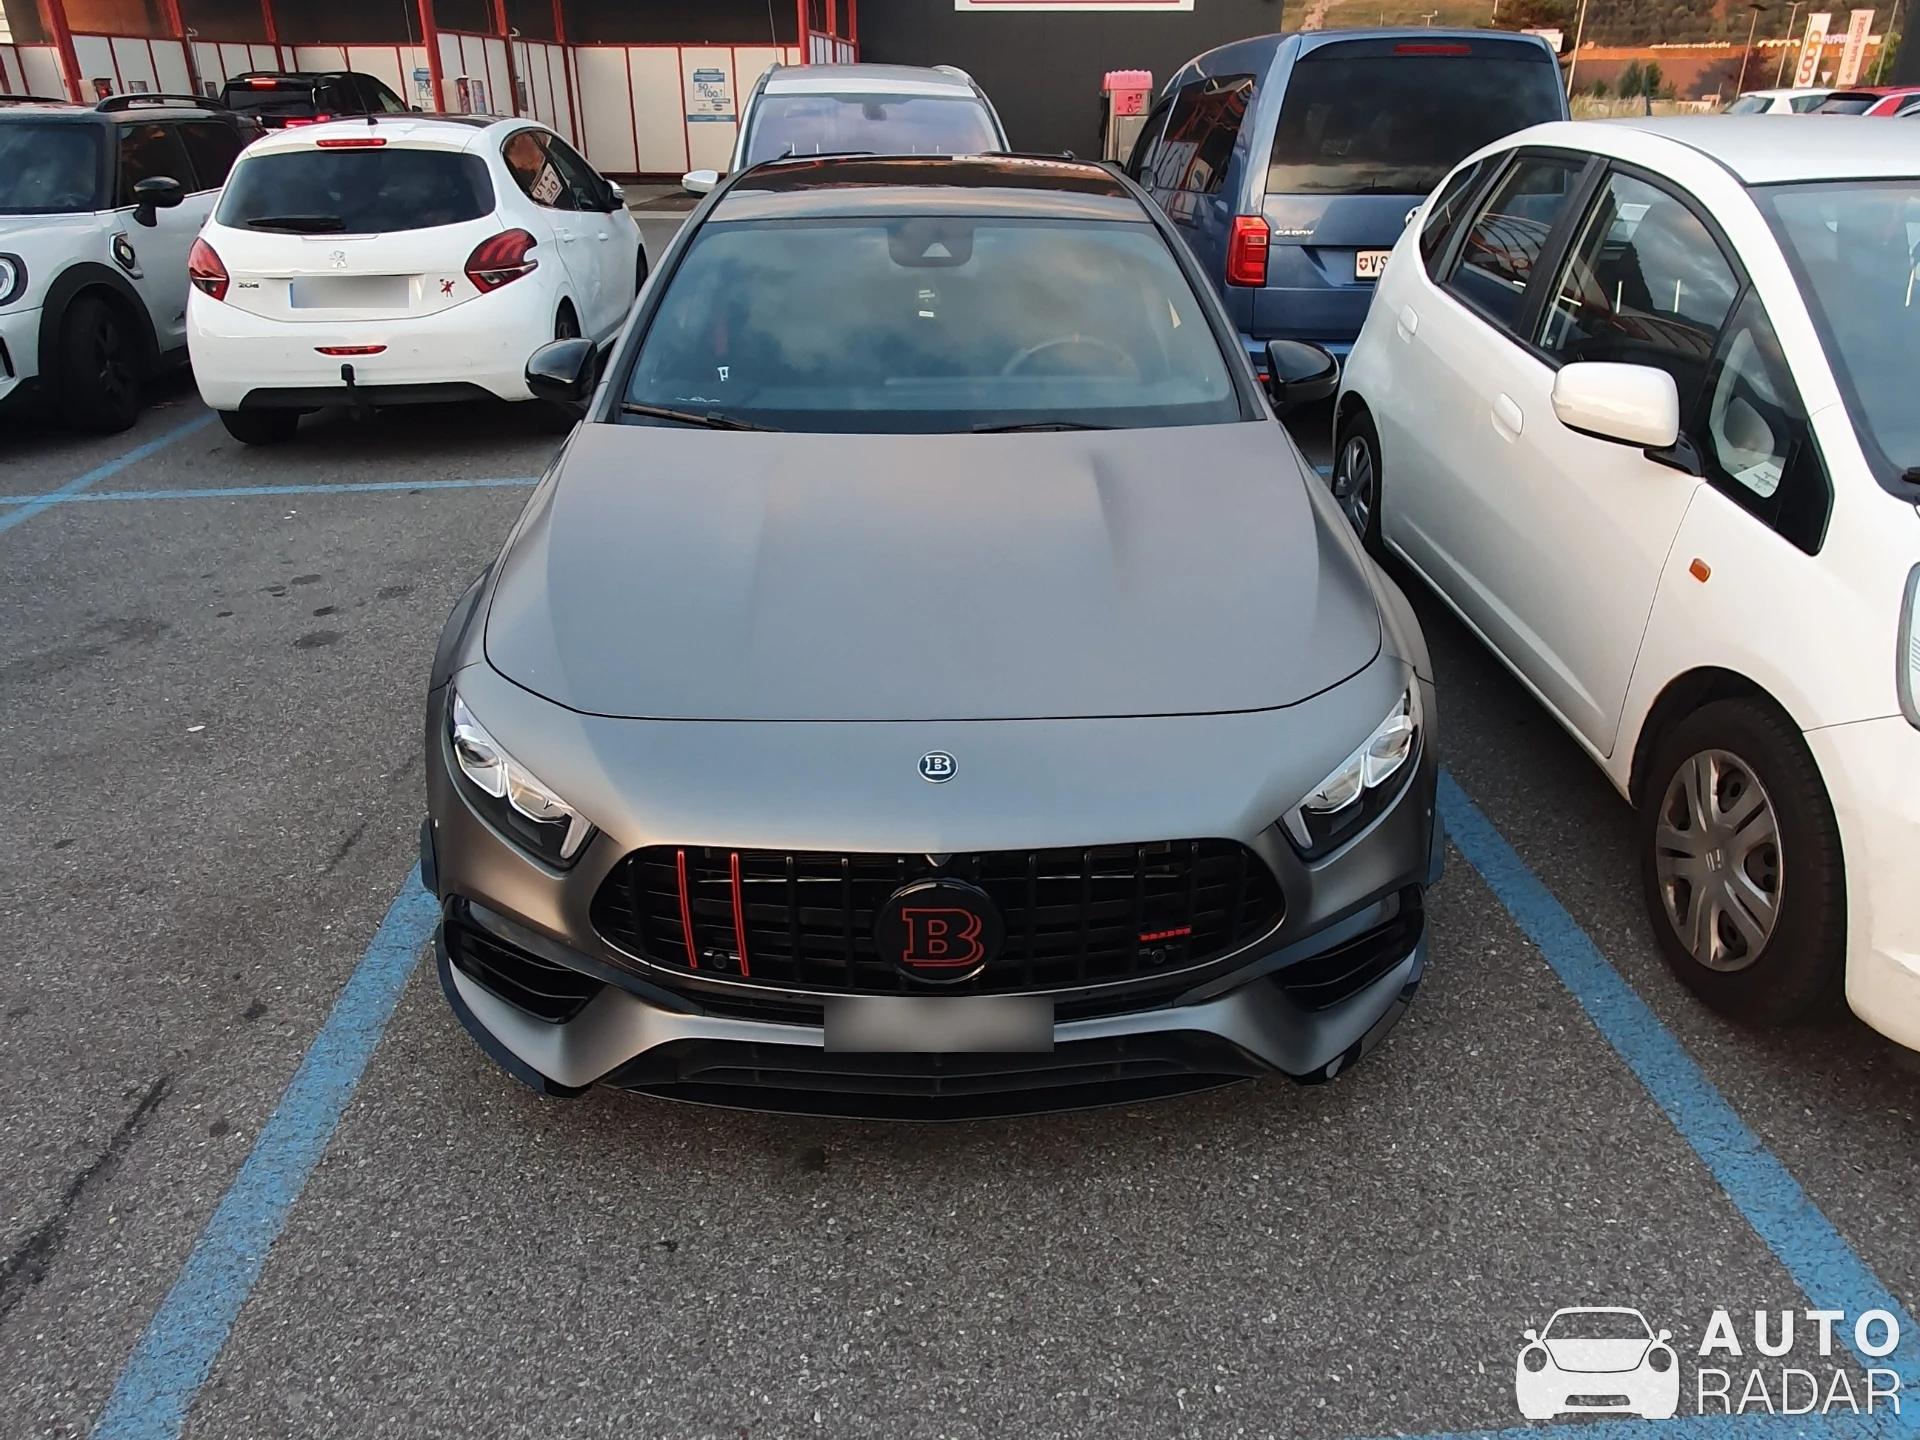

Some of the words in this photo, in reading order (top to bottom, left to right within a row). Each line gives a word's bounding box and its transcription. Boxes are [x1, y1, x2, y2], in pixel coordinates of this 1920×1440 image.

[1854, 15, 1867, 44] STORE
[1799, 30, 1824, 84] coop
[704, 89, 719, 98] 100
[902, 907, 985, 968] B
